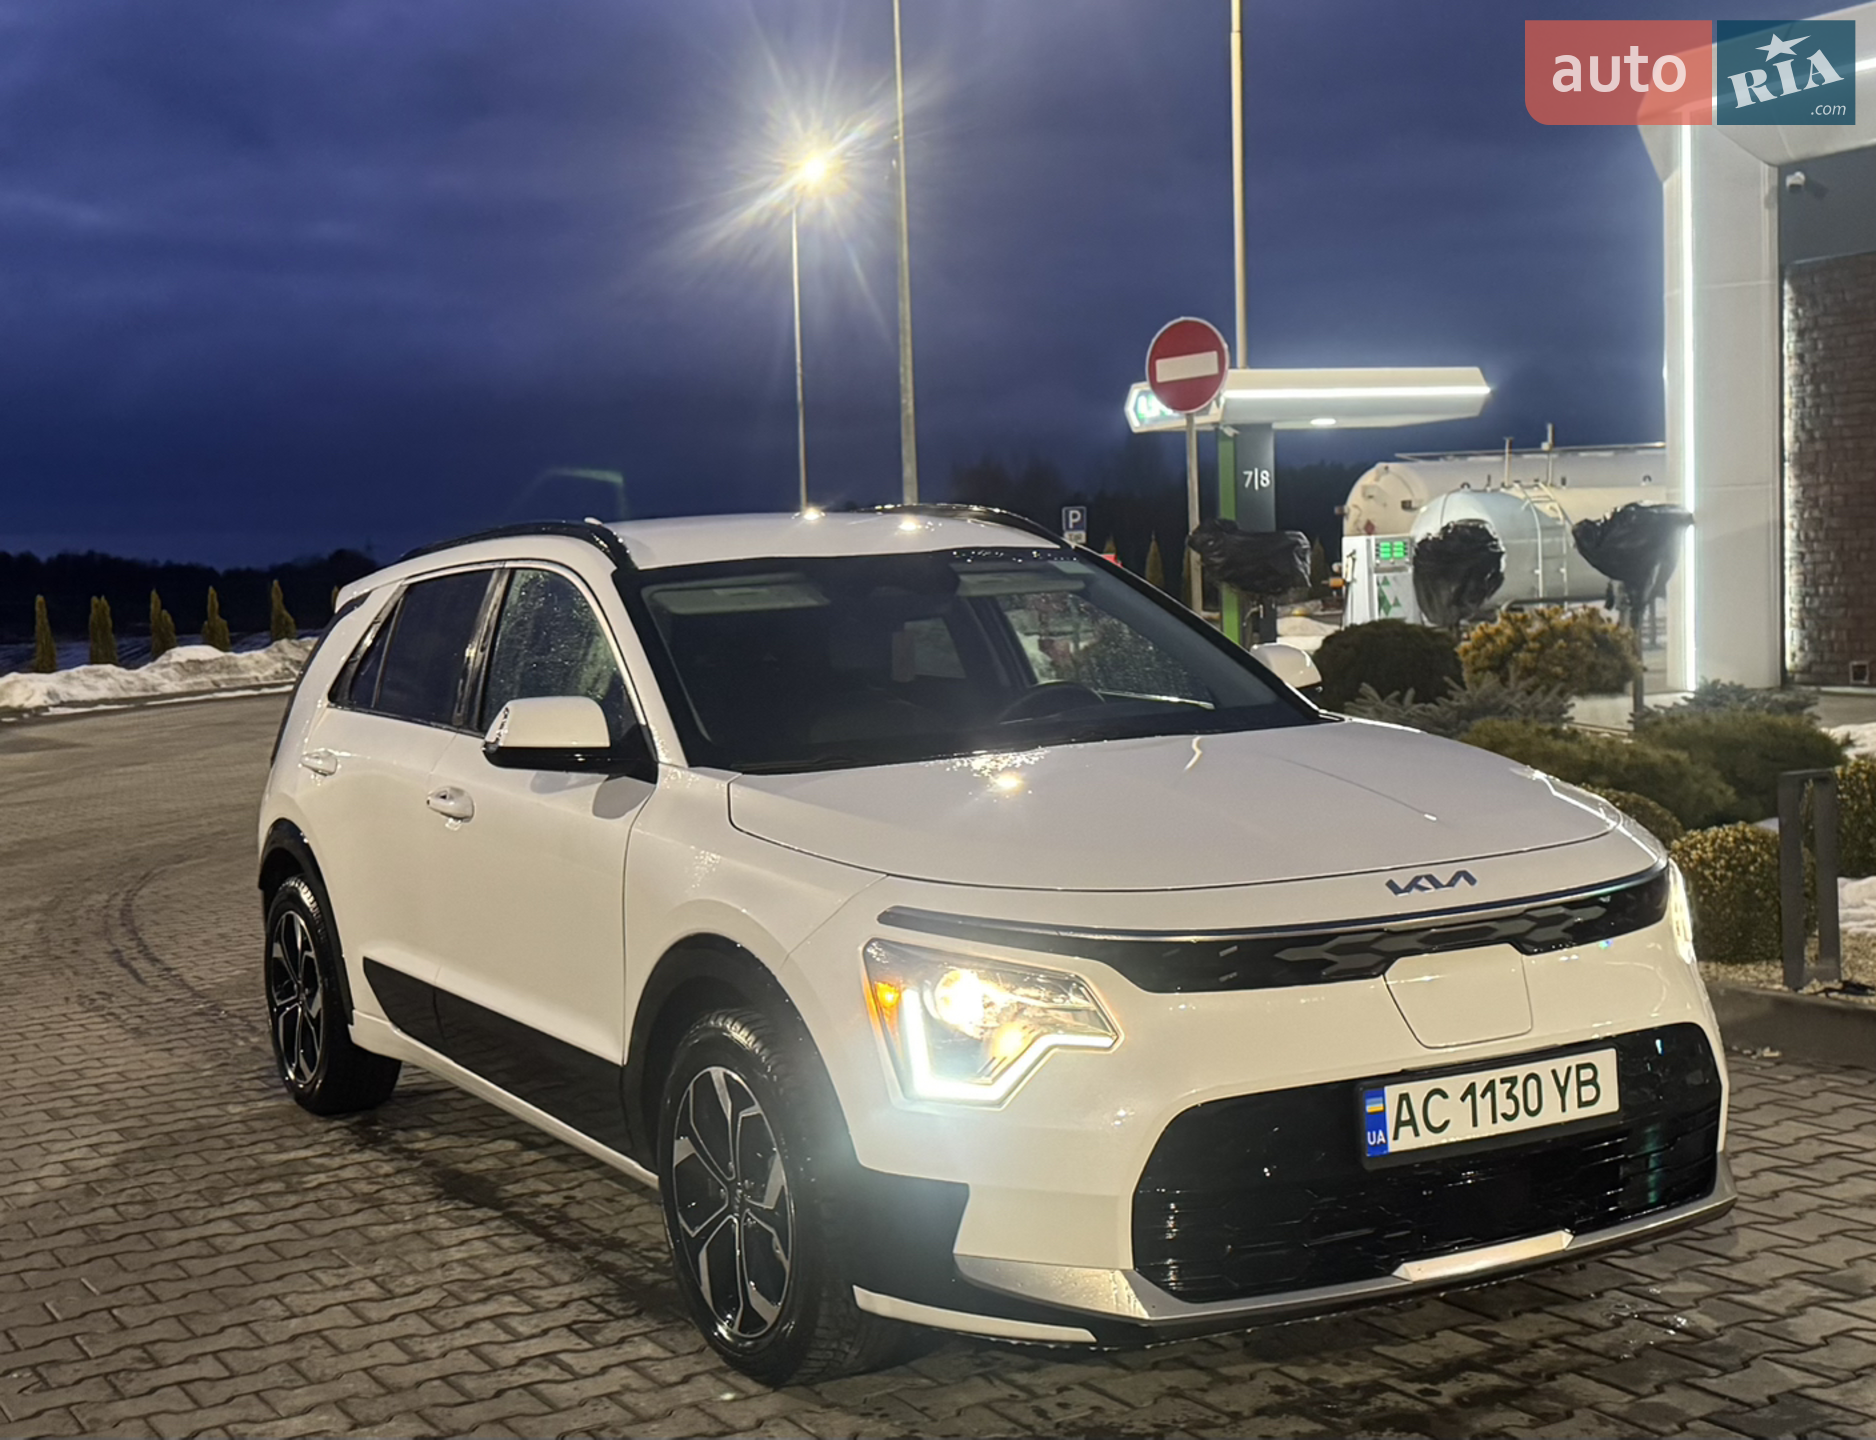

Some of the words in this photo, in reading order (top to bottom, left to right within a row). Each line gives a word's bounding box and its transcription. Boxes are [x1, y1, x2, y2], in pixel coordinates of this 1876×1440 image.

[1069, 510, 1081, 528] P
[1385, 870, 1477, 896] KIA
[1392, 1087, 1450, 1141] AC
[1460, 1072, 1543, 1128] 1130
[1551, 1062, 1601, 1113] YB
[1367, 1130, 1386, 1146] UA
